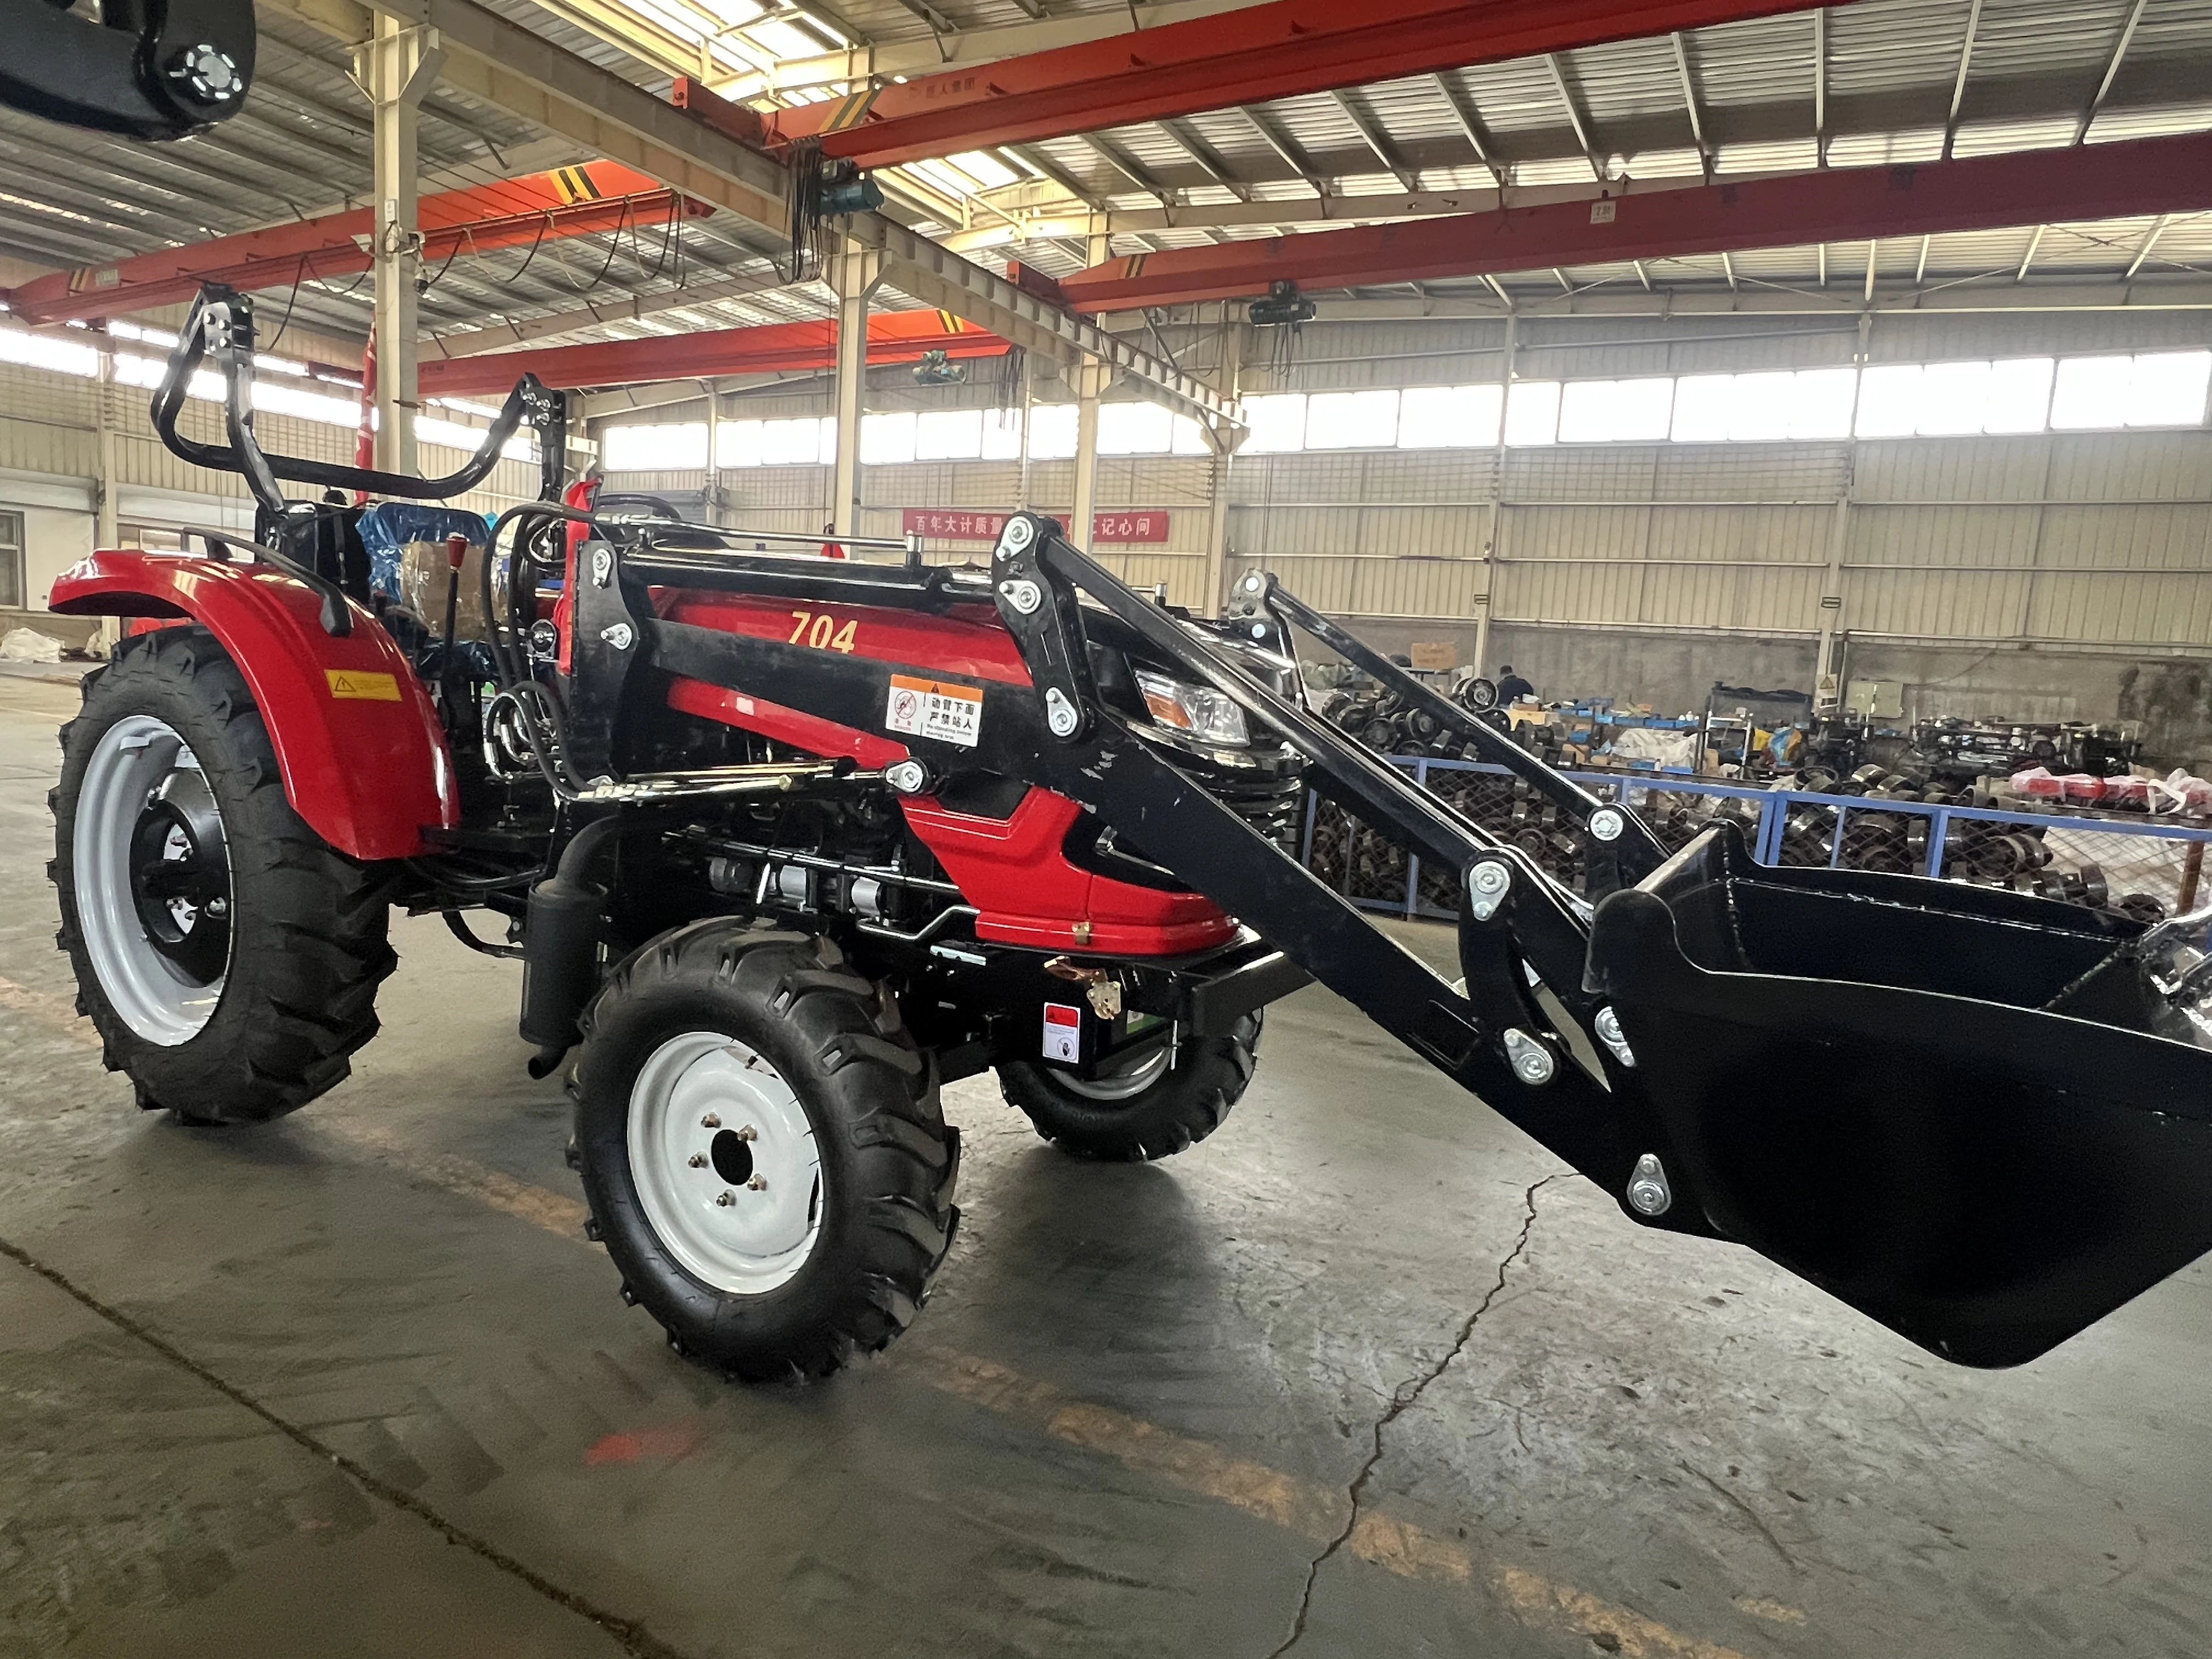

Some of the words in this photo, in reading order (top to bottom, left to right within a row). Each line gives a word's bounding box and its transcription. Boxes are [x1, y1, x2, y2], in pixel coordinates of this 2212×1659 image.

[1093, 518, 1150, 536] 记心间
[788, 611, 858, 654] 704
